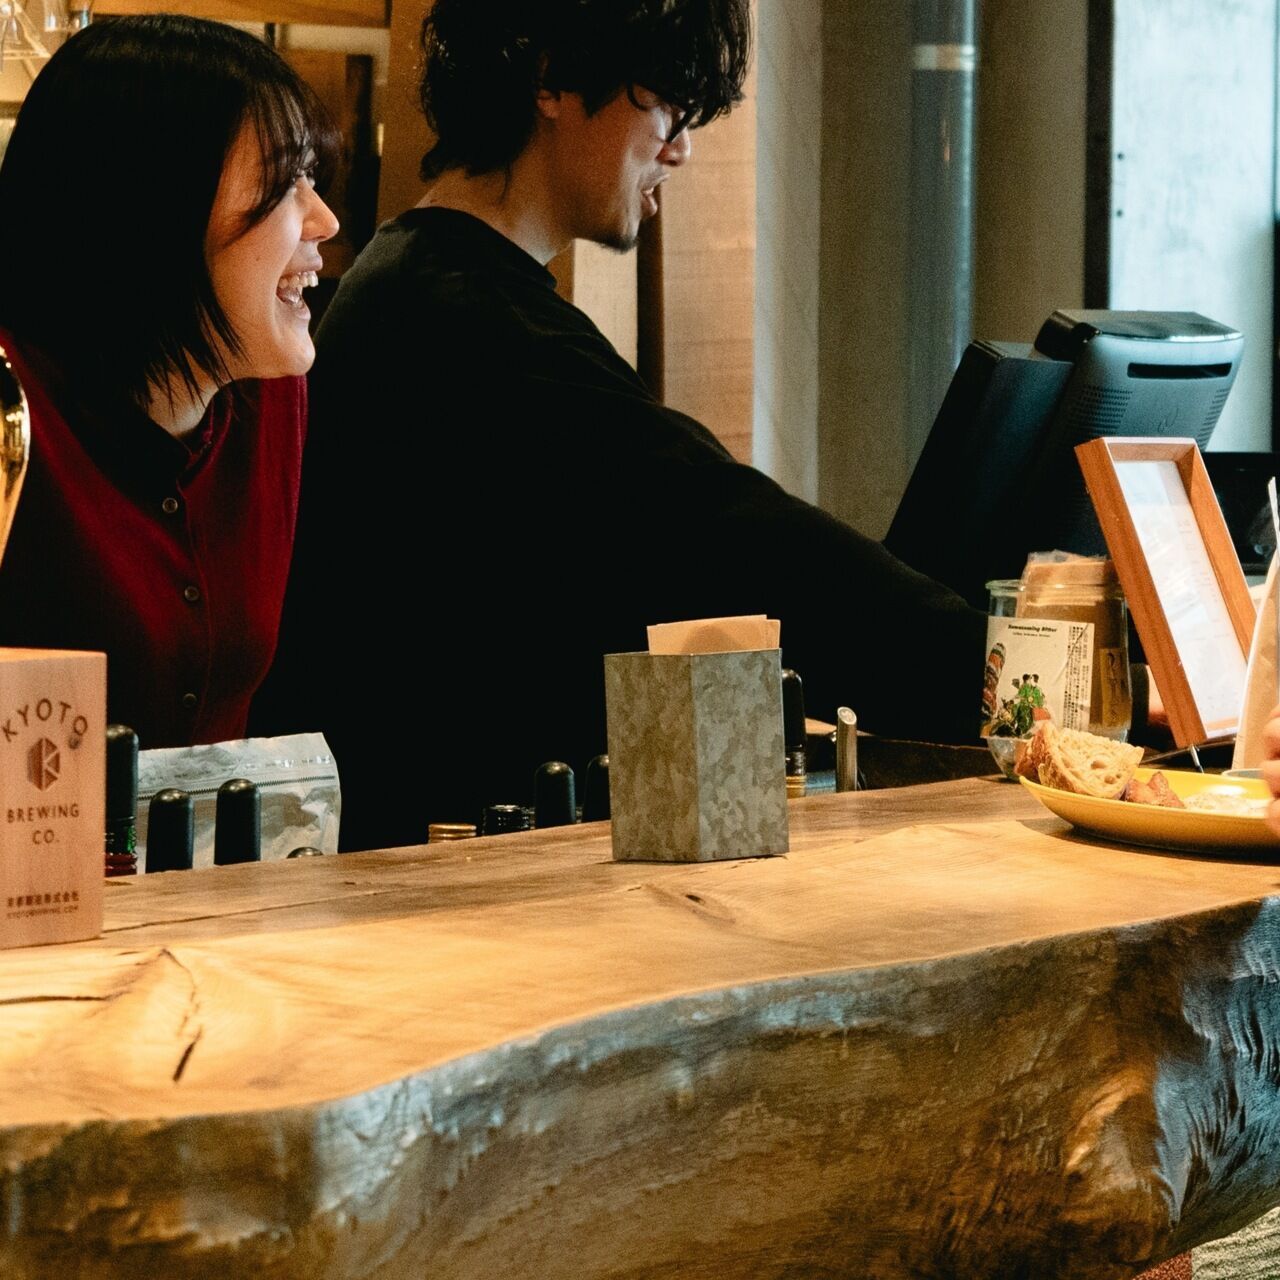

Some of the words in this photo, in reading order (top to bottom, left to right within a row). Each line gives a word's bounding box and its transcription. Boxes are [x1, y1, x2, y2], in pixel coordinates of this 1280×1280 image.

[2, 698, 88, 742] KYOTO
[7, 803, 79, 824] BREWING
[32, 829, 60, 845] CO.
